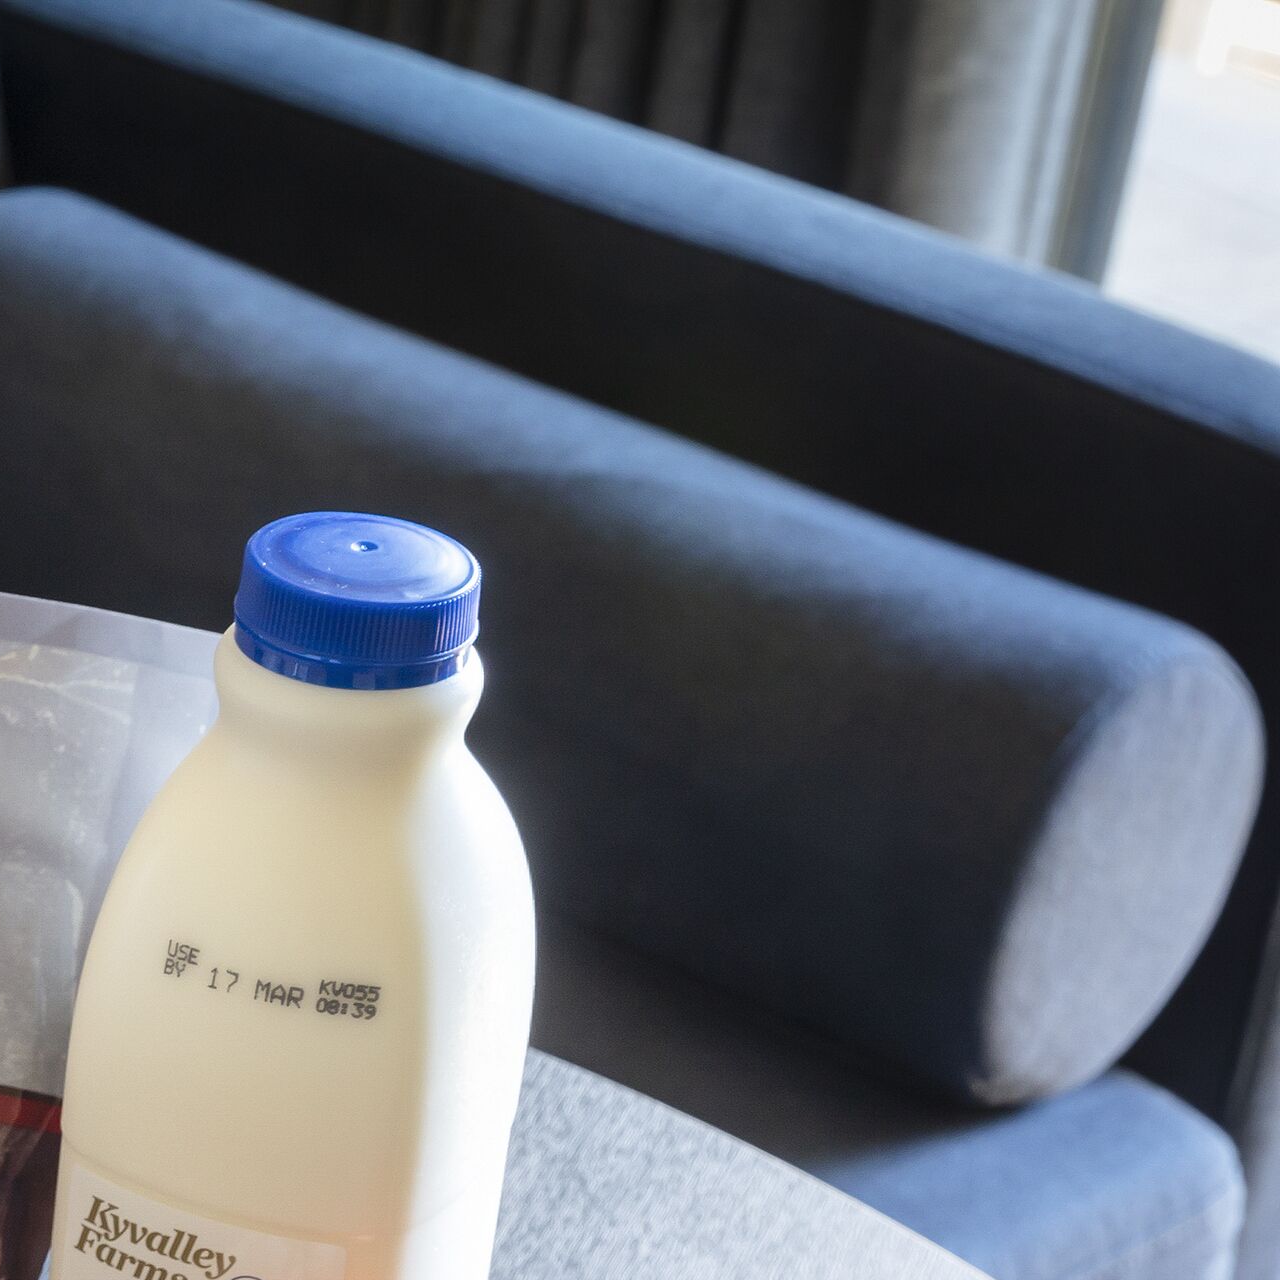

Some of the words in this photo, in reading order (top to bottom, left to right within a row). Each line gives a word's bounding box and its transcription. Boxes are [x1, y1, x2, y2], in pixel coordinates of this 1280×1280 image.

[163, 958, 186, 978] BY
[166, 939, 200, 966] USE
[207, 967, 240, 993] 17
[253, 979, 305, 1009] MAR
[84, 1195, 237, 1280] Kyvalley
